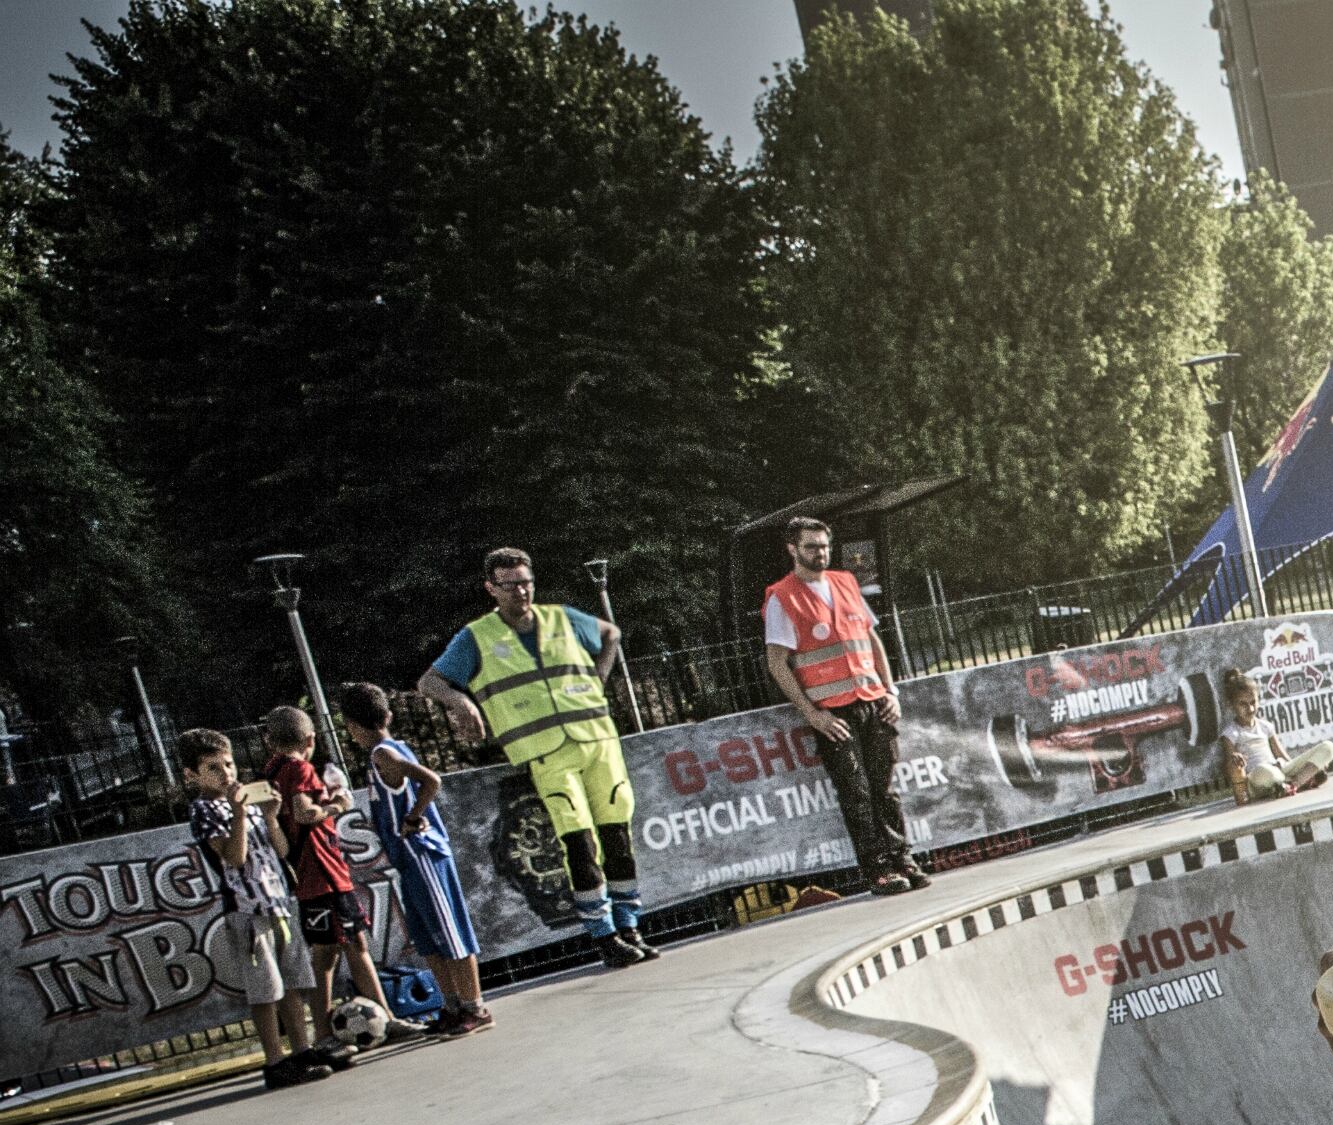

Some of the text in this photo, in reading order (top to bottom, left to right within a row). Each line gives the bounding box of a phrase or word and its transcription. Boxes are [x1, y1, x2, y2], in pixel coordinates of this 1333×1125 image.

[1267, 646, 1315, 670] Red Bull
[1050, 679, 1149, 723] #NOCOMPLY
[664, 725, 824, 797] G-SHO
[642, 789, 778, 851] OFFICIAL
[28, 950, 129, 1015] IN
[1054, 910, 1248, 998] G-SHOCK
[1107, 967, 1224, 1026] #NOCOMPLY
